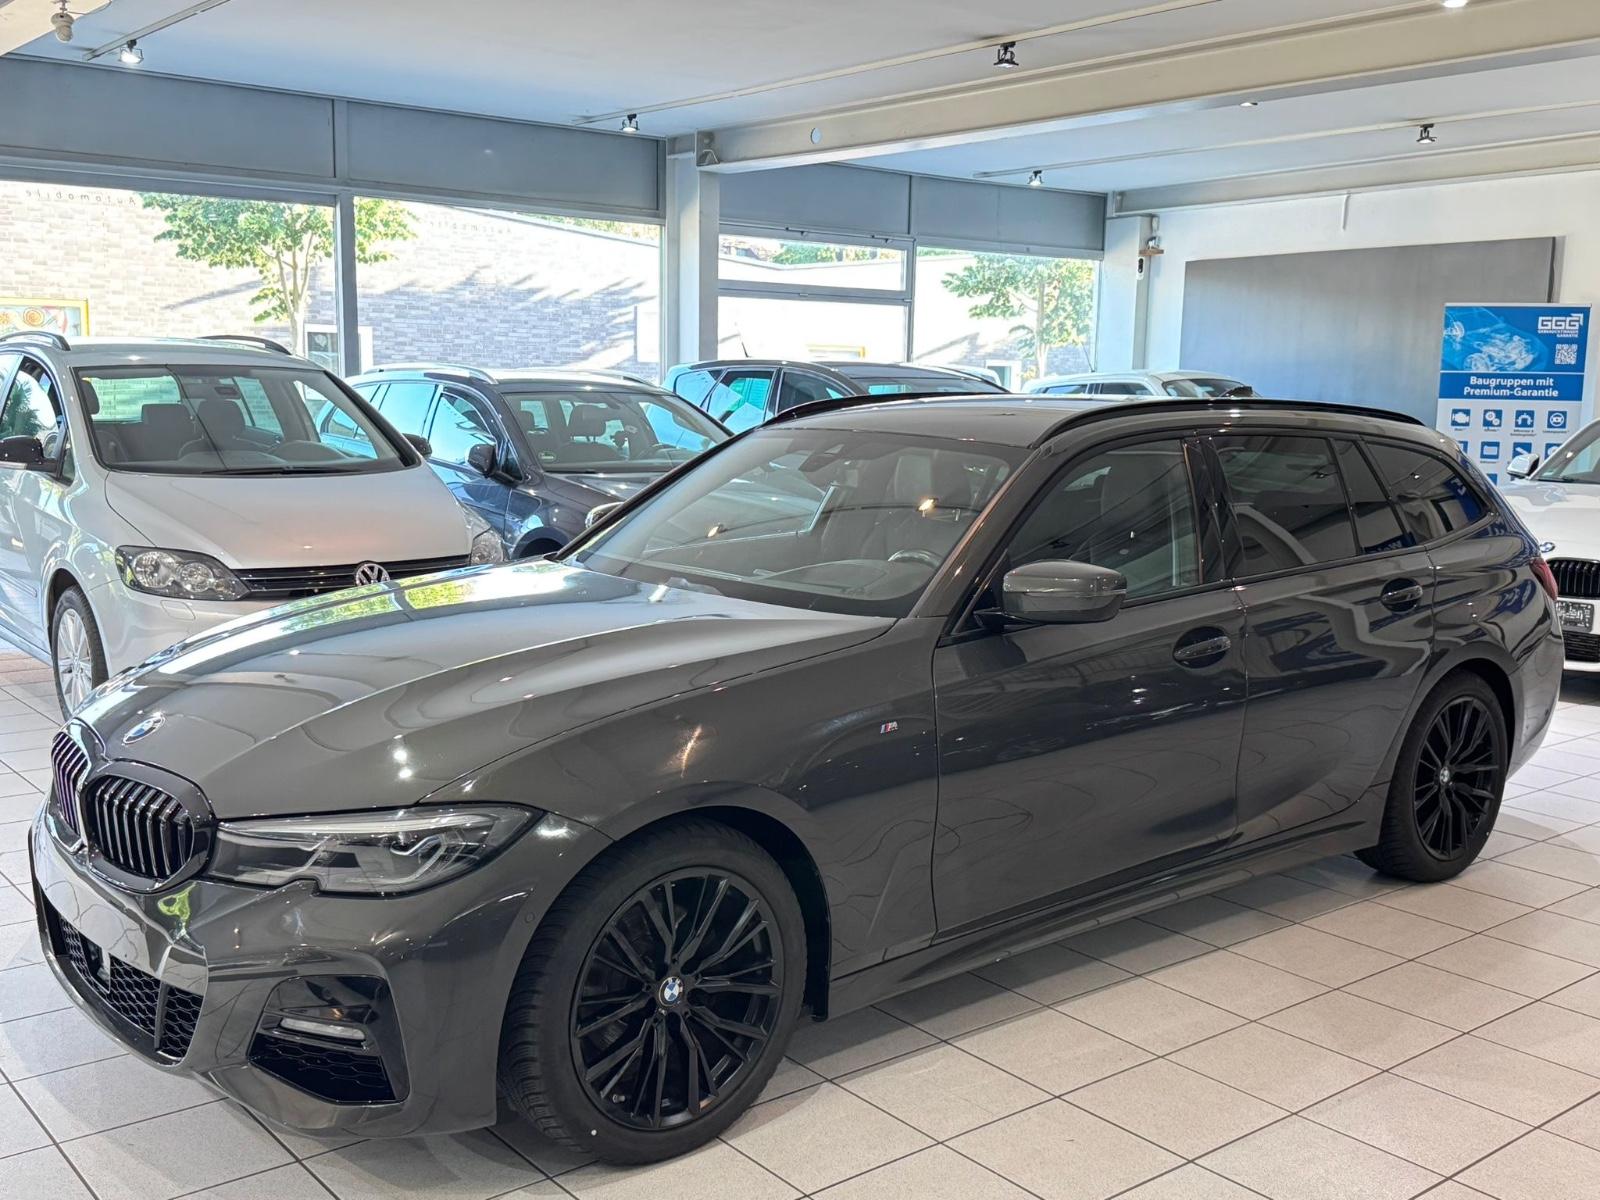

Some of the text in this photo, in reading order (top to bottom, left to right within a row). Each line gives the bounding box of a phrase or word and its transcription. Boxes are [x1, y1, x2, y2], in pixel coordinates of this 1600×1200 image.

[1537, 316, 1580, 330] GGG
[1470, 376, 1554, 387] Baugruppen mit
[1463, 387, 1559, 397] Premium-Garantie
